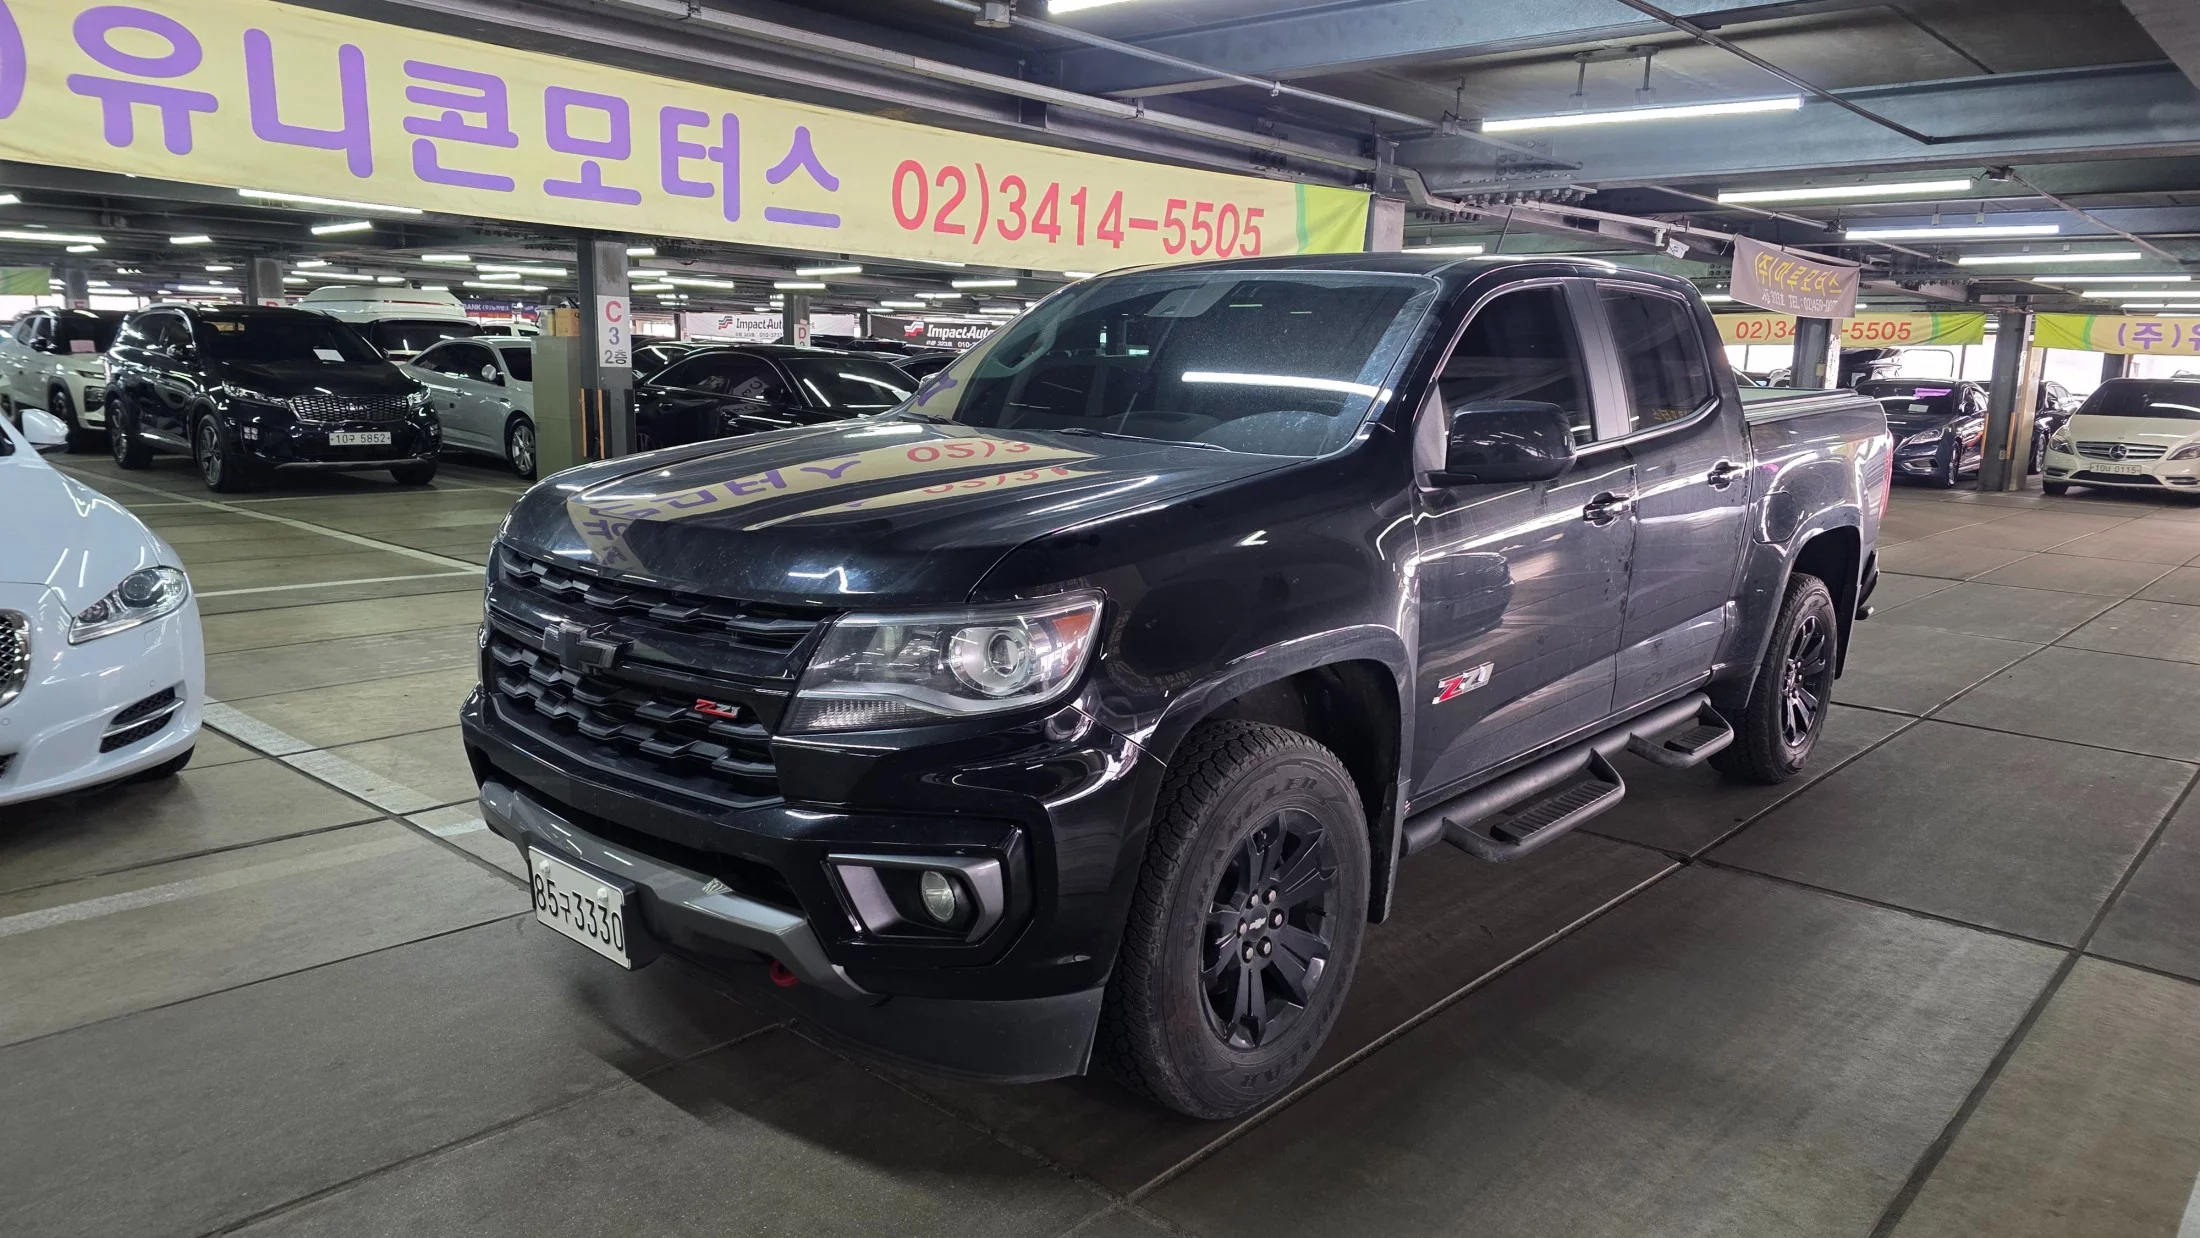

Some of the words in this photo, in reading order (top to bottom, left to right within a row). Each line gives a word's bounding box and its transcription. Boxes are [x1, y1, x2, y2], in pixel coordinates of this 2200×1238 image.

[891, 159, 1265, 258] 02)3414-5505
[605, 300, 622, 323] C
[736, 317, 783, 331] ImpactAut
[798, 327, 807, 339] D
[608, 326, 620, 346] 3
[604, 349, 628, 365] 2층
[360, 433, 386, 443] 5852
[2114, 465, 2137, 474] 0115
[1432, 661, 1495, 705] Z71
[694, 698, 741, 719] Z71
